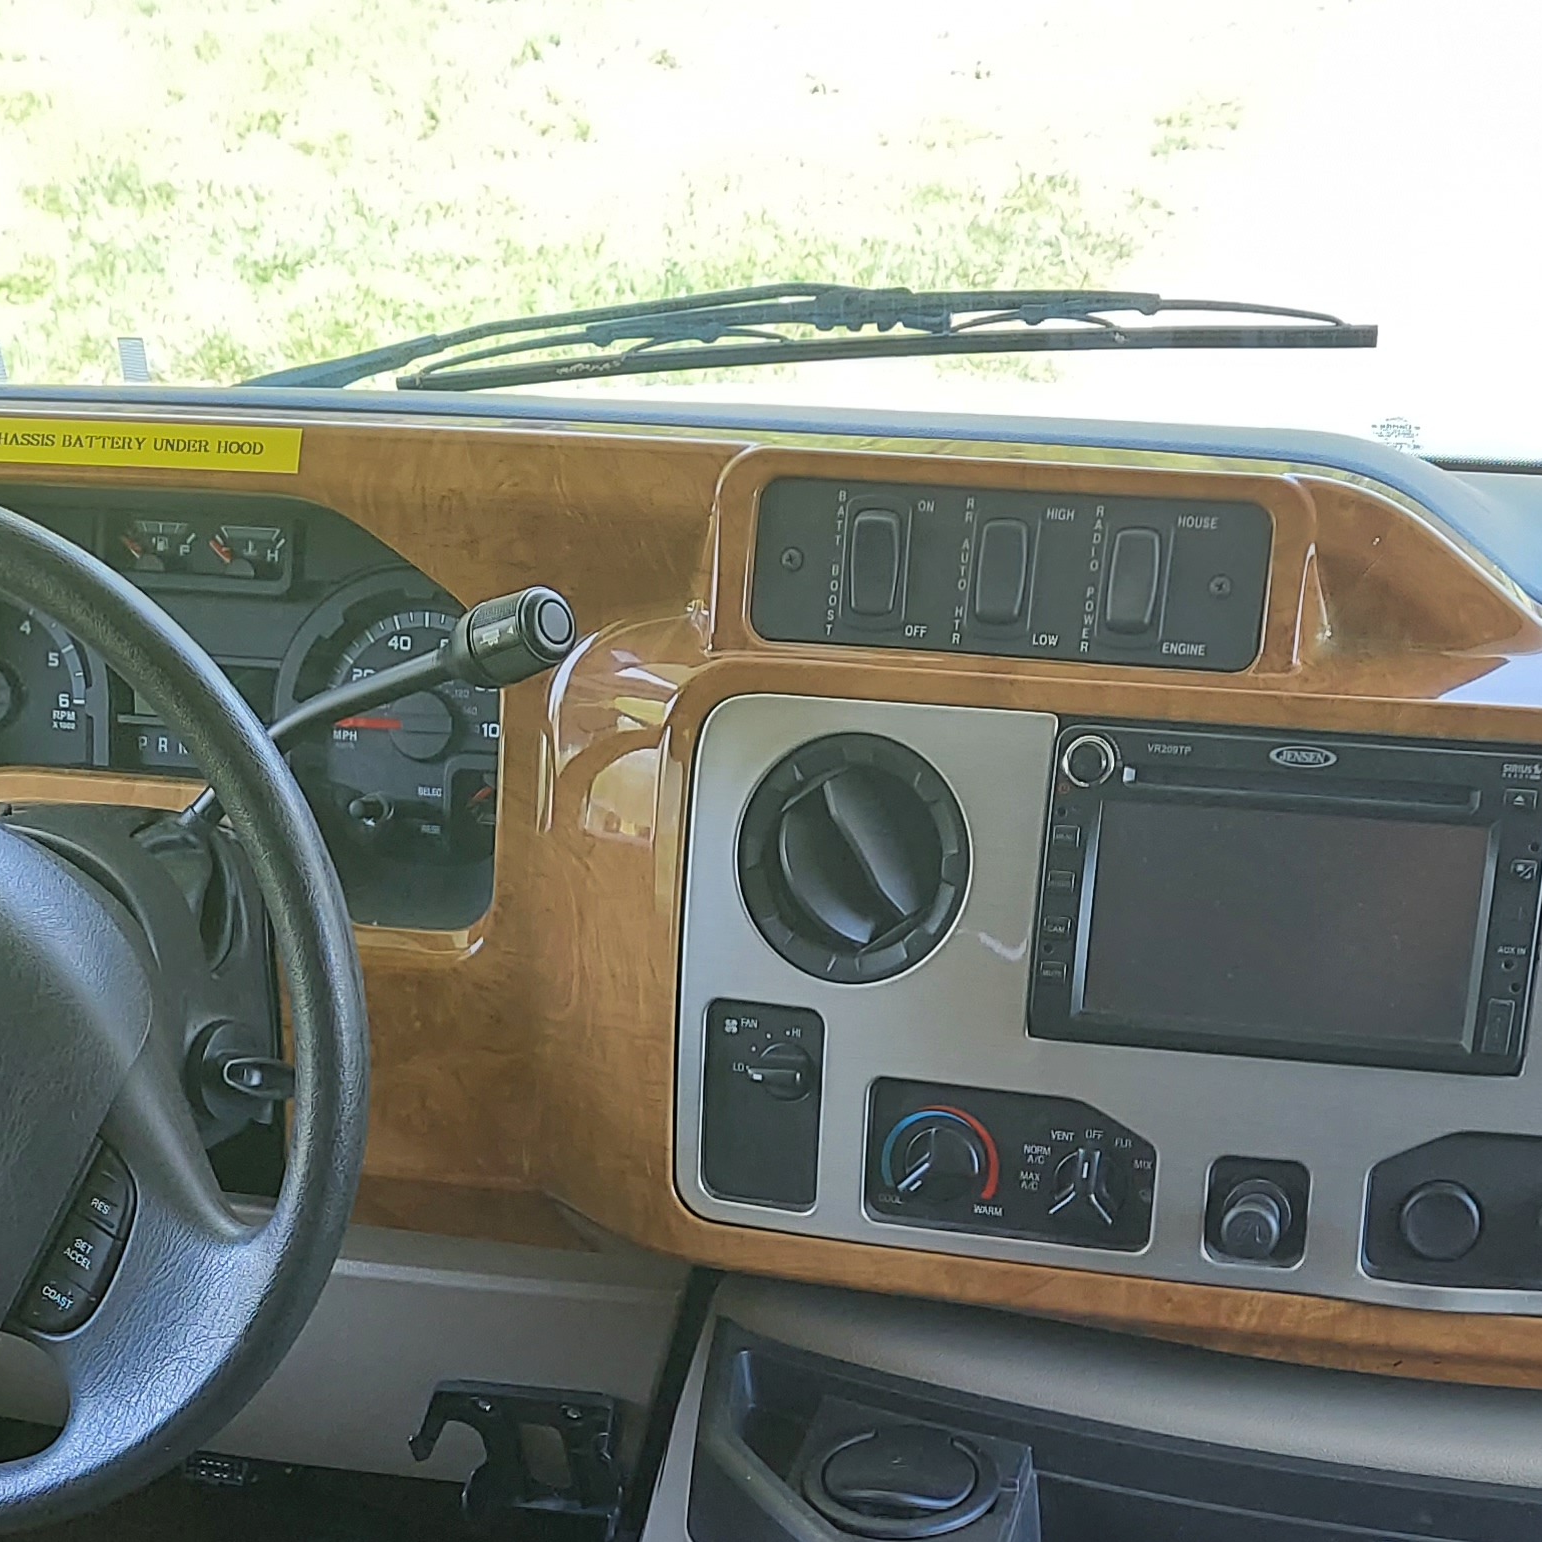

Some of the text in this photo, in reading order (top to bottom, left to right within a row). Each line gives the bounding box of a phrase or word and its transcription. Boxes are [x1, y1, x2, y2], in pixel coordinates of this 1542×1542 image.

[62, 435, 146, 450] BATTERY
[153, 438, 209, 452] UNDER
[216, 440, 264, 455] HOOD
[918, 500, 935, 513] ON
[1046, 508, 1075, 521] HIGH
[1177, 515, 1219, 529] HOUSE
[267, 549, 278, 562] H
[825, 490, 847, 635] BATT BOOST
[958, 538, 970, 590] AUTO
[1080, 505, 1104, 652] RADIO POWER
[19, 620, 31, 635] 4
[905, 625, 927, 638] OFF
[952, 606, 963, 645] HTR
[387, 636, 412, 651] 40
[1032, 634, 1059, 646] LOW
[1162, 642, 1206, 656] ENGINE
[48, 652, 59, 667] 5
[58, 694, 70, 708] 6
[52, 710, 76, 721] RPM
[333, 730, 358, 741] MPH
[158, 737, 168, 753] R
[1147, 743, 1192, 755] VR209TP
[1279, 752, 1326, 764] JENSEN
[741, 1018, 758, 1029] FAN
[792, 1028, 801, 1038] HI
[733, 1062, 745, 1072] LO
[1051, 1129, 1075, 1141] VENT
[1085, 1129, 1103, 1140] OFF
[1024, 1144, 1051, 1155] NORM
[1027, 1155, 1045, 1164] A/C
[1020, 1171, 1040, 1181] MAX
[1021, 1181, 1039, 1190] A/C
[90, 1198, 111, 1215] RES
[974, 1204, 1003, 1217] WARM
[74, 1238, 93, 1254] SET
[63, 1247, 91, 1271] ACCEL
[42, 1285, 74, 1310] COAST
